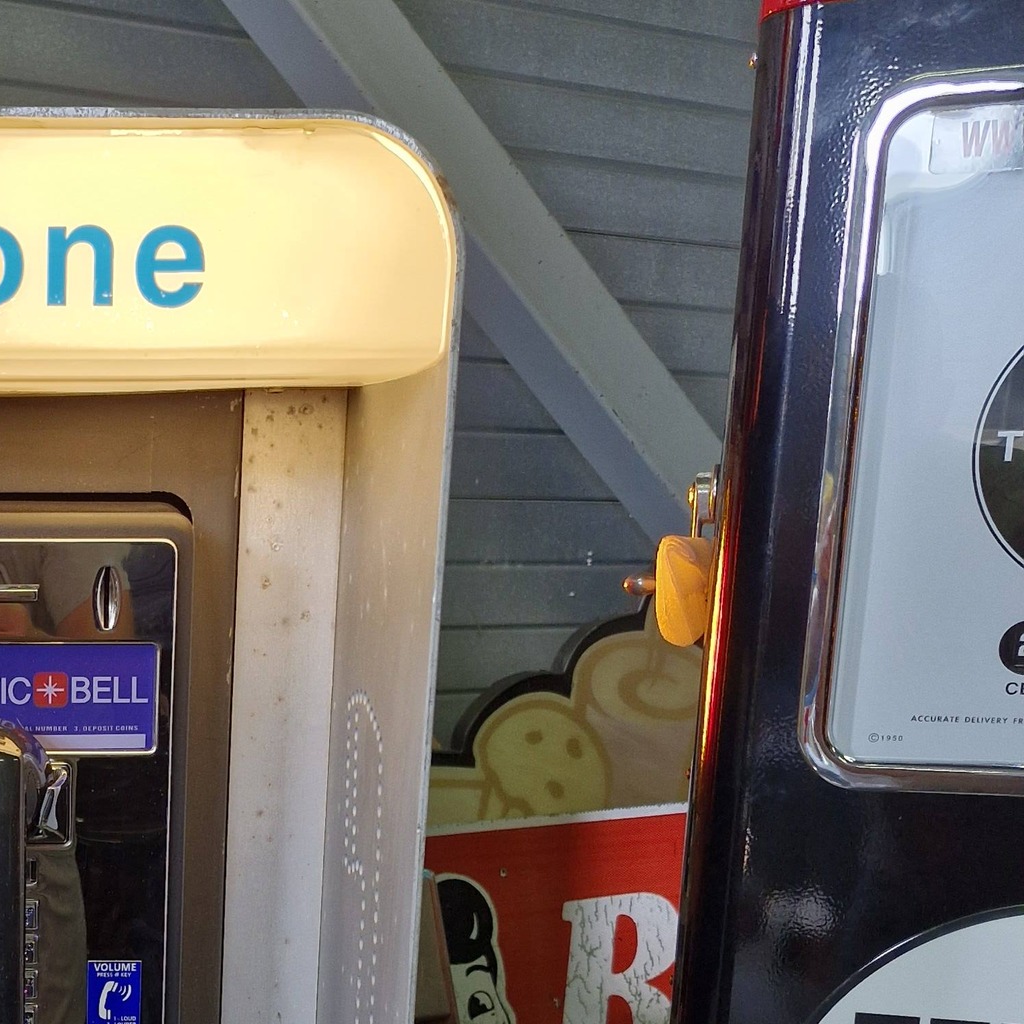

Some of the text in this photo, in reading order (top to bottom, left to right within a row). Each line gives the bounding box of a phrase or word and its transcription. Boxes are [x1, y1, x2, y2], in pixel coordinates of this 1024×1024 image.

[71, 676, 148, 704] BELL
[911, 715, 959, 723] ACCURATE
[94, 963, 136, 972] VOLUME
